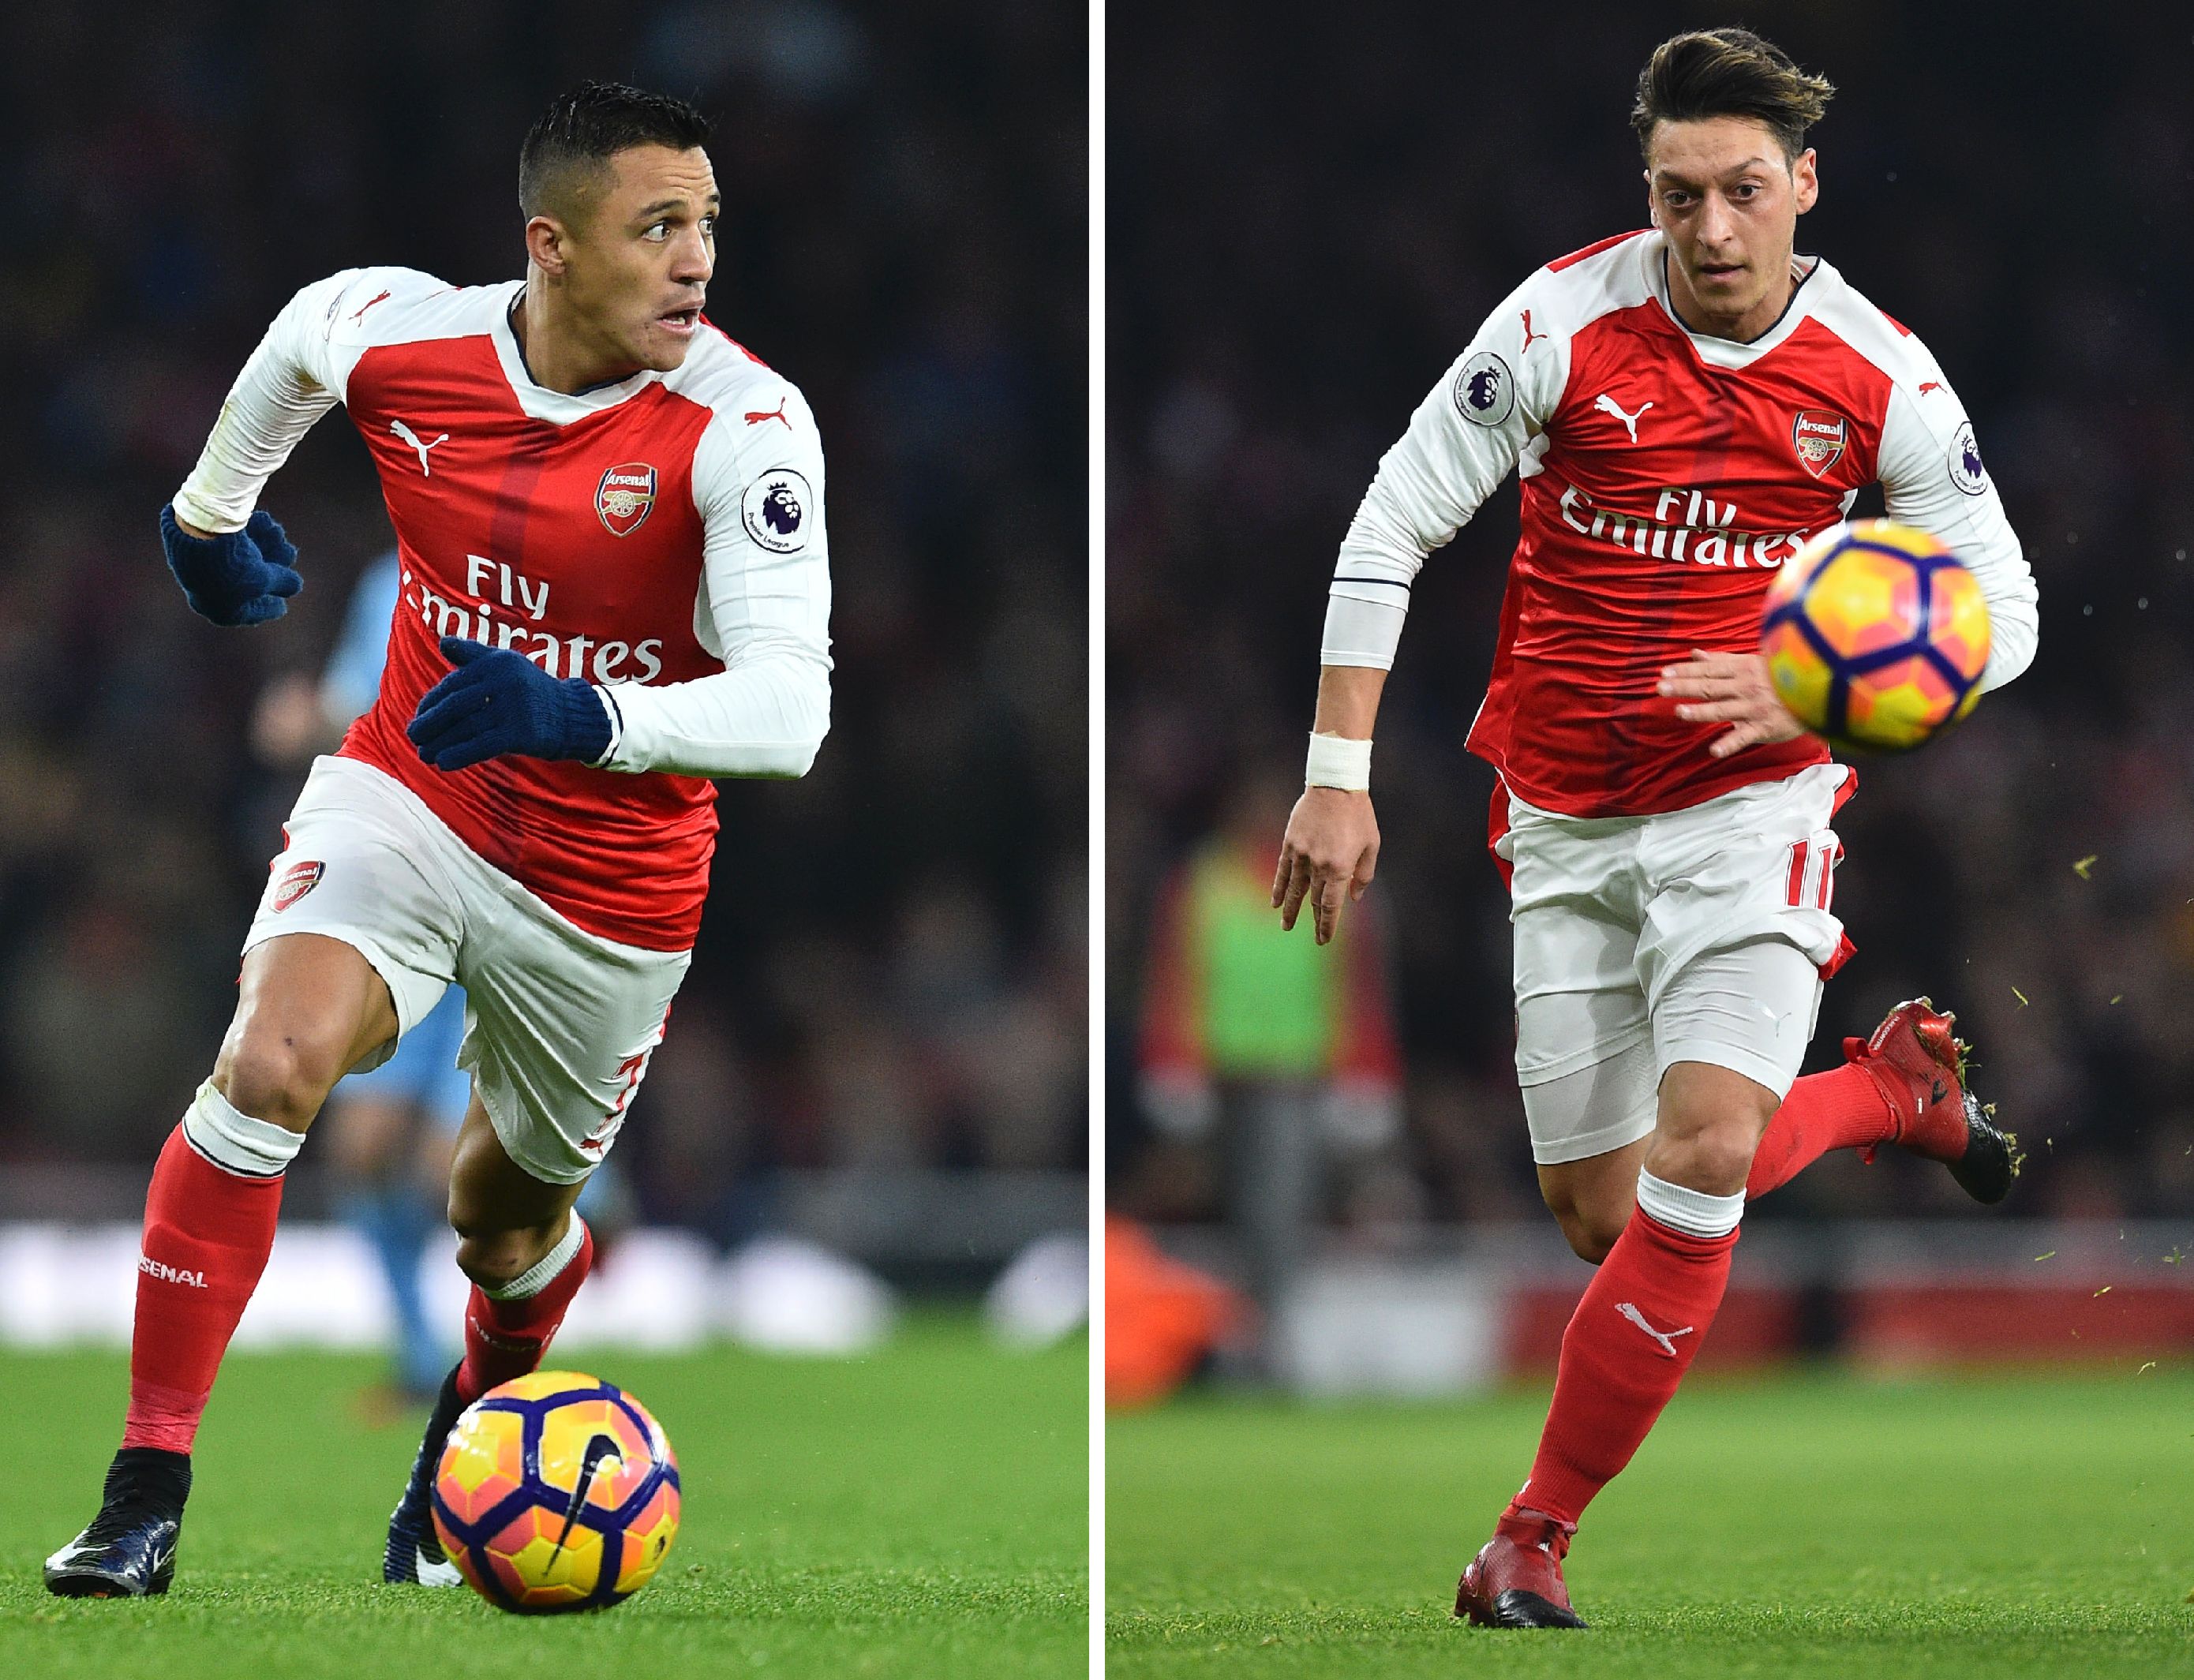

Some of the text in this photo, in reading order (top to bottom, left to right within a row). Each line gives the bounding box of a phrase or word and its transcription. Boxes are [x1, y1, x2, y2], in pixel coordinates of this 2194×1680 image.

[1799, 419, 1840, 436] Arsenal
[606, 473, 650, 487] Arsenal
[1559, 483, 1810, 568] Emirates
[1655, 486, 1737, 528] Fly
[747, 511, 789, 548] Premier League
[466, 554, 549, 620] Fly
[402, 570, 663, 686] mirates
[1784, 838, 1834, 914] 11
[139, 1255, 209, 1289] SENAL
